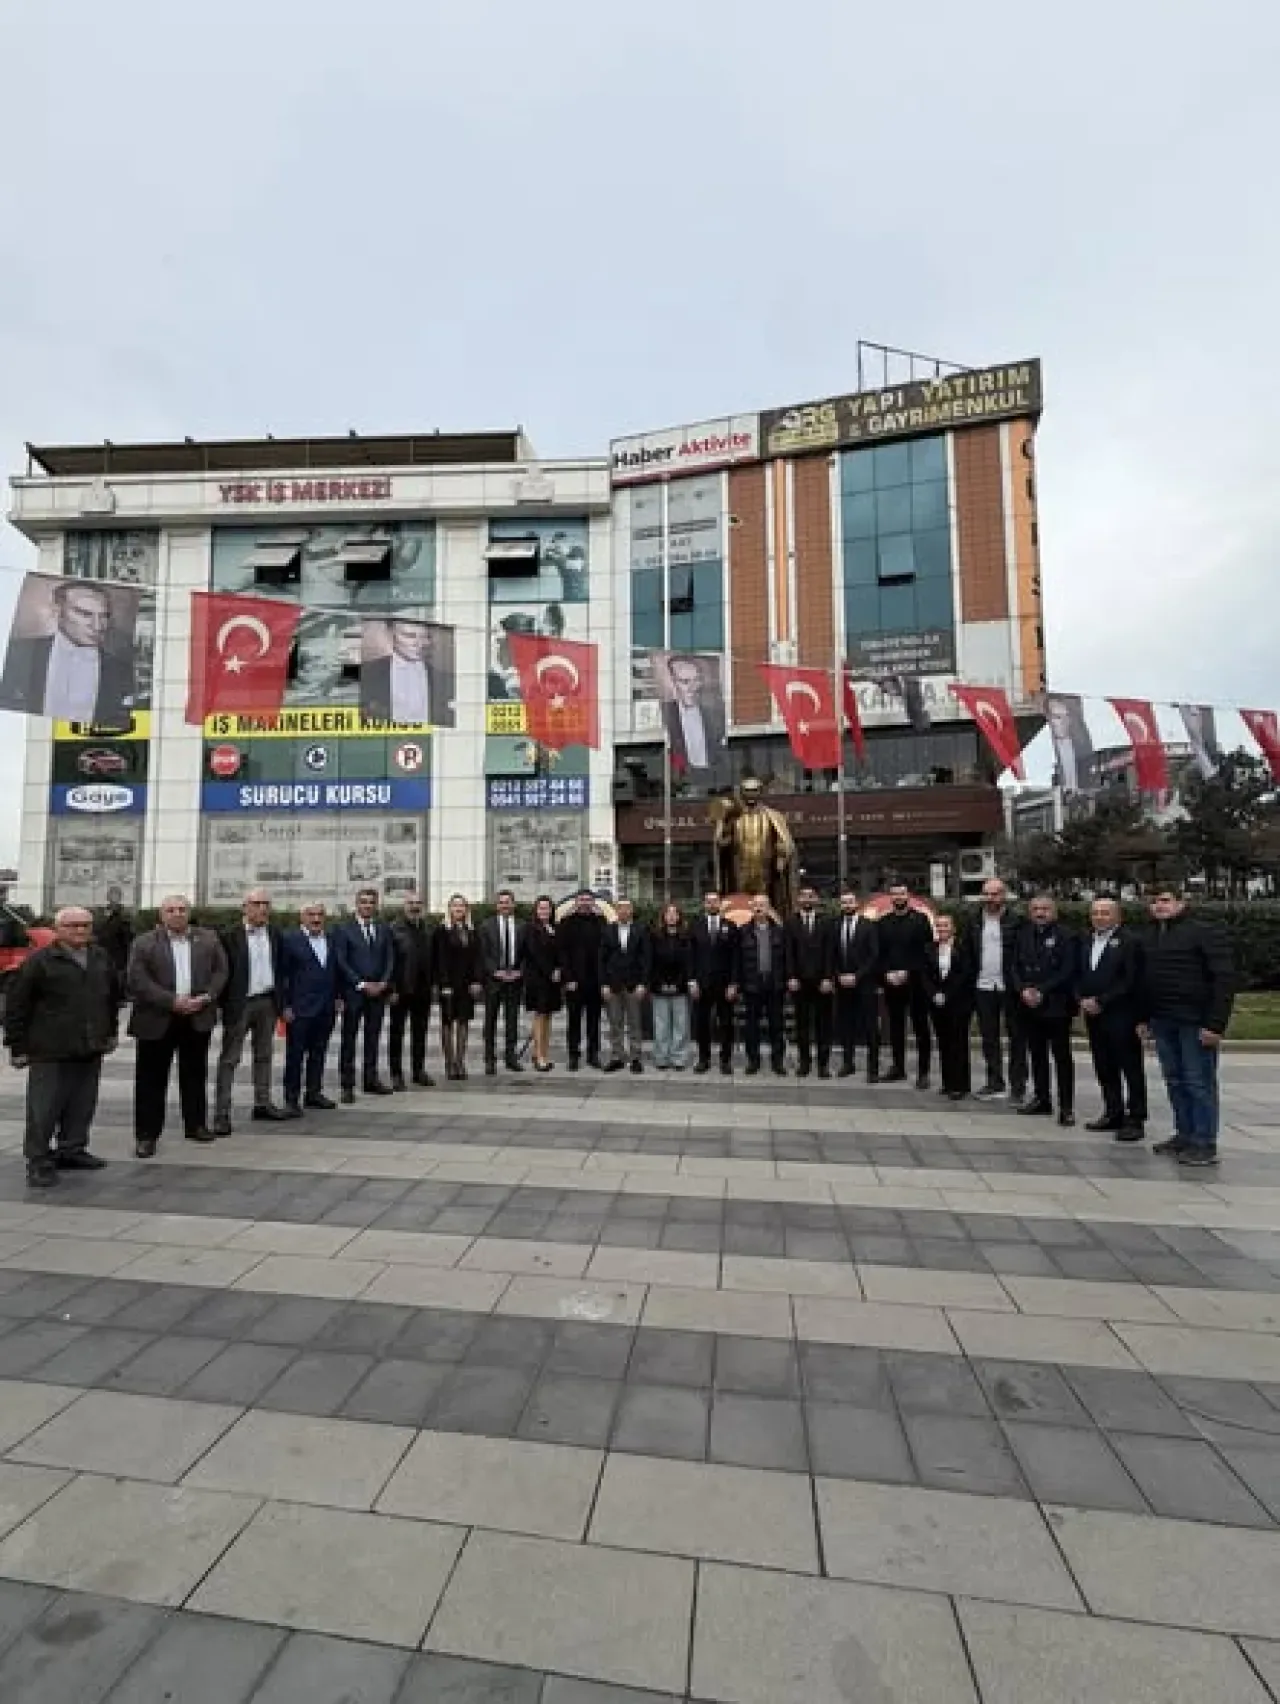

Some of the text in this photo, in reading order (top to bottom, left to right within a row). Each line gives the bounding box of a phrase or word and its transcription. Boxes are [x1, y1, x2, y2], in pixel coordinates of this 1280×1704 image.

[848, 366, 1031, 418] YAPI YATIRIM
[613, 446, 673, 468] Haber
[326, 784, 391, 805] KURSU
